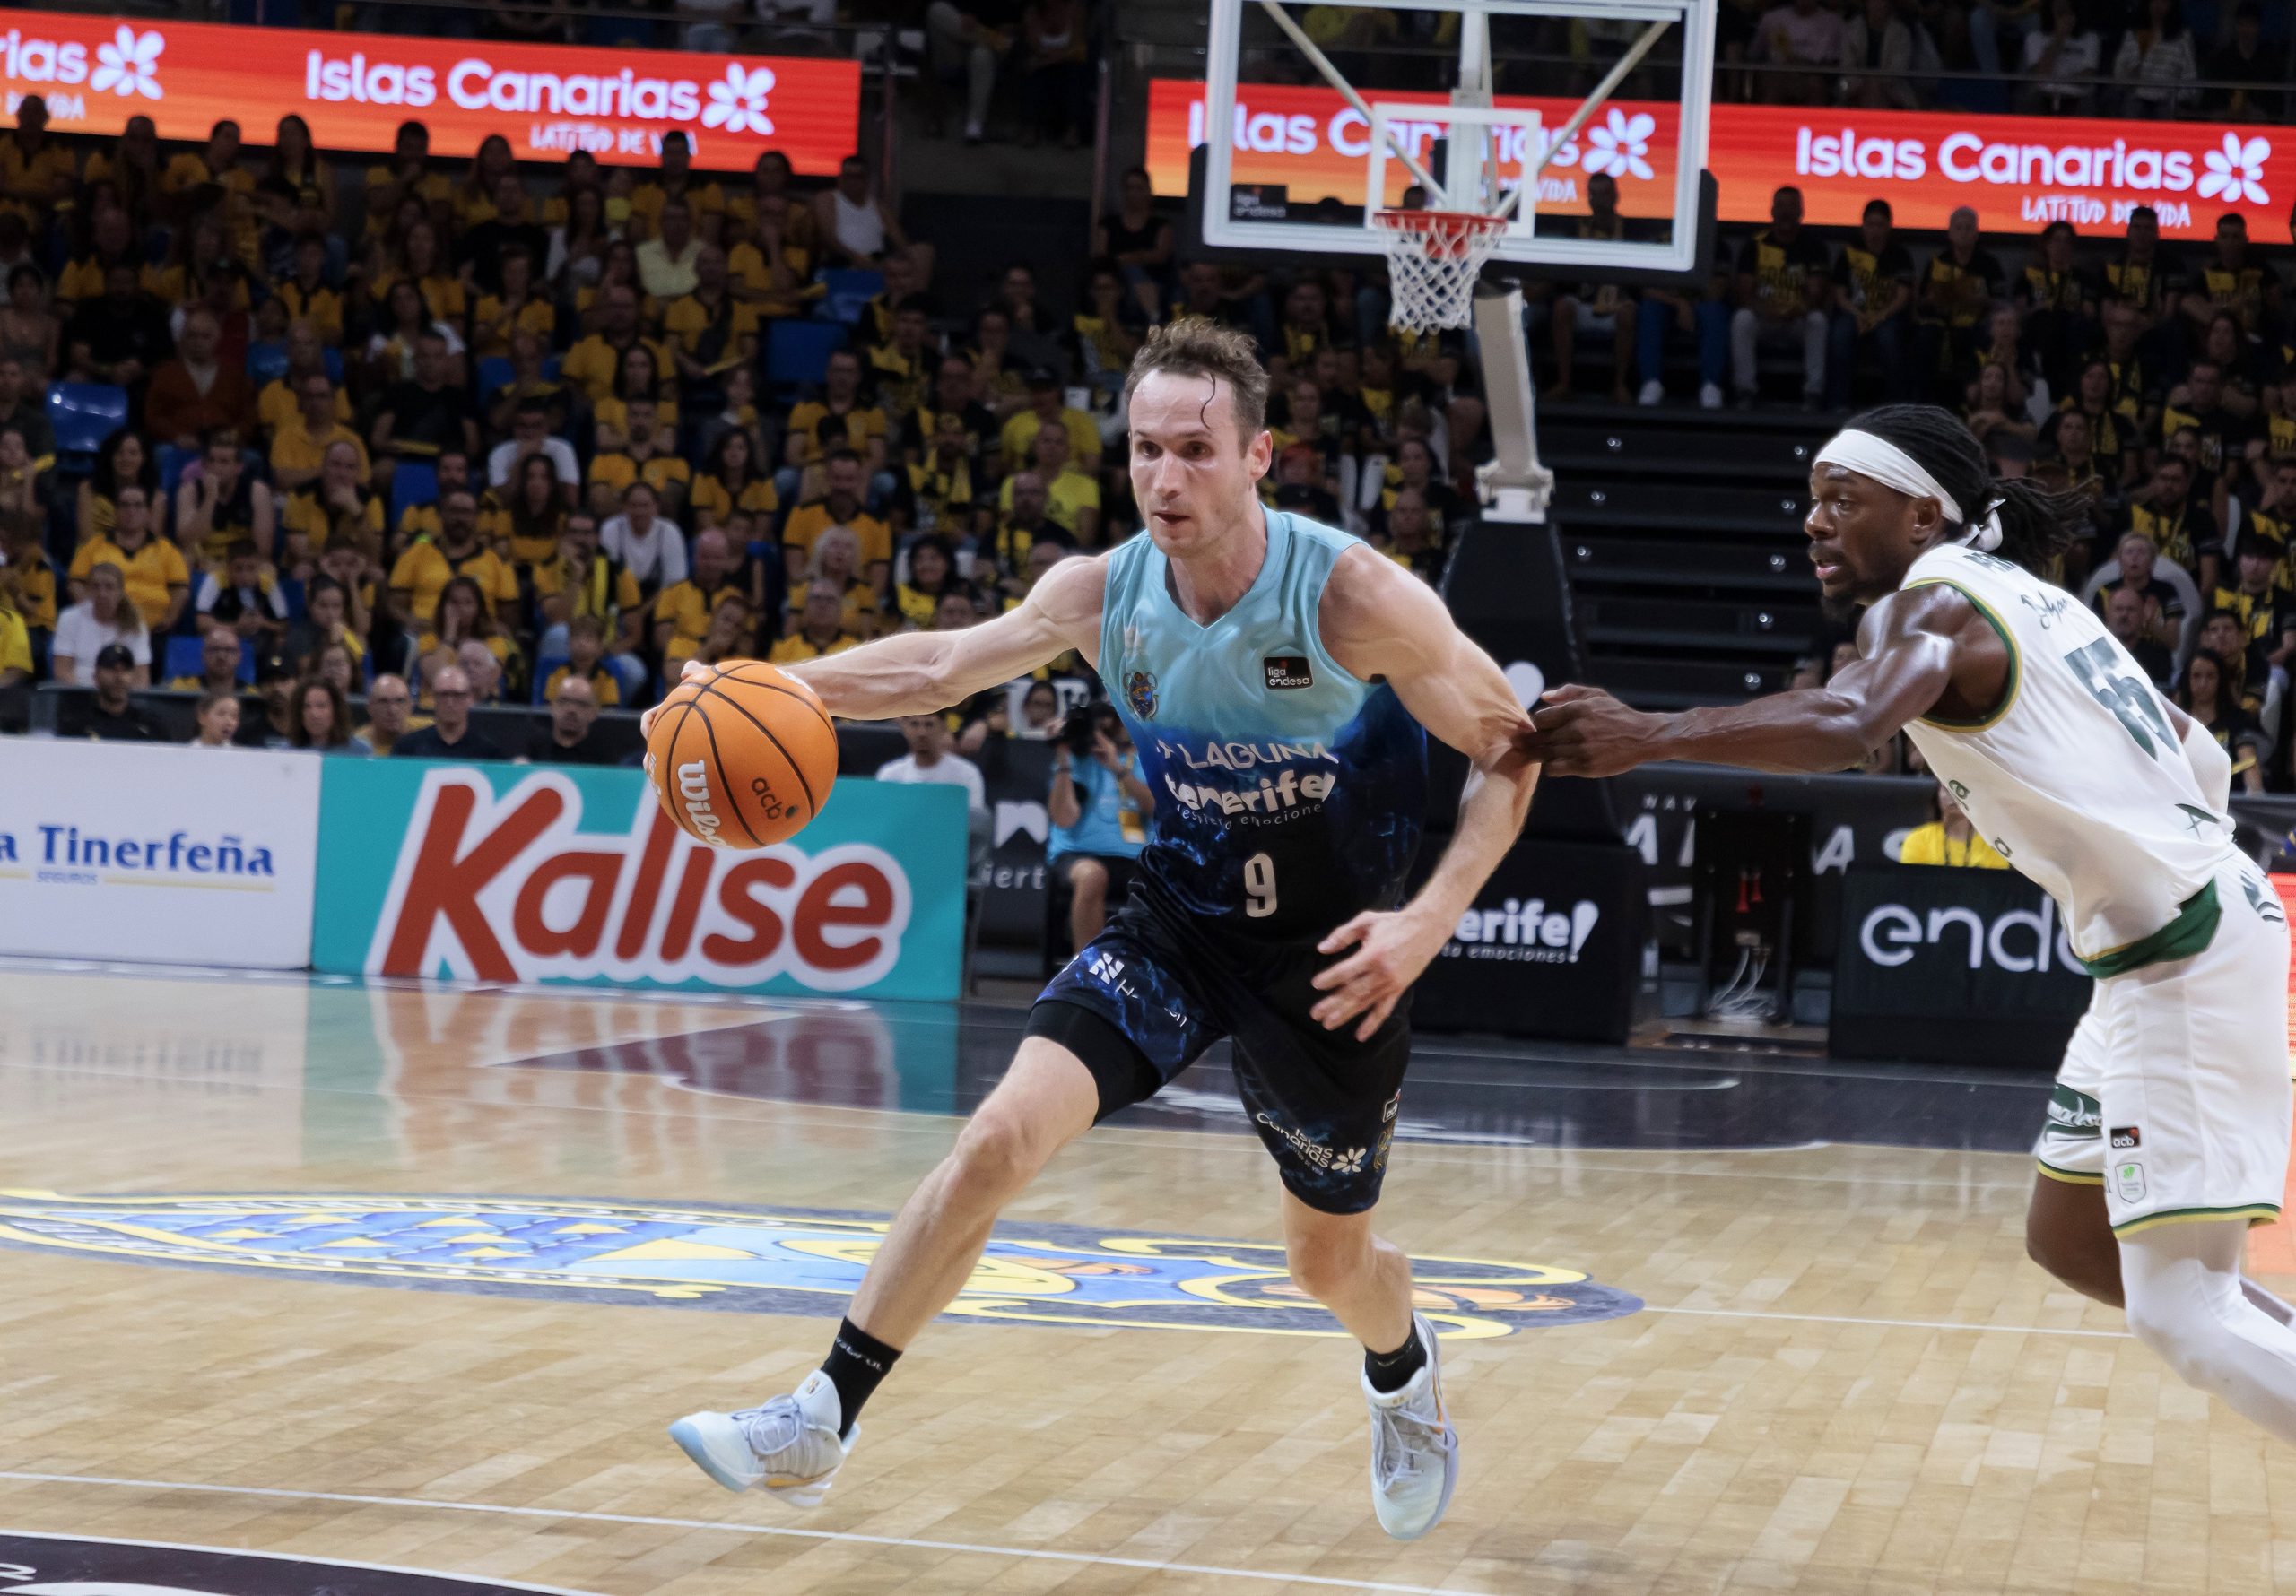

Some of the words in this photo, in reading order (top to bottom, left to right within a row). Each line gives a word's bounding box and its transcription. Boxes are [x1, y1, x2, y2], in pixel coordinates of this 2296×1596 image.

[306, 50, 435, 106] Islas
[447, 58, 700, 122] Canarias
[1188, 100, 1318, 155] Ilas
[1796, 126, 1926, 180] Islas
[1937, 132, 2195, 192] Canarias
[2021, 195, 2106, 224] LATITUD
[1268, 666, 1286, 679] liga
[1269, 676, 1309, 686] endesa
[752, 776, 783, 820] acb
[38, 824, 274, 877] Tinerfeña
[380, 783, 895, 984] Kalise
[1244, 853, 1278, 918] 9
[1257, 1112, 1329, 1168] Canarias
[1294, 1128, 1334, 1159] Islas
[2113, 1134, 2135, 1148] acb
